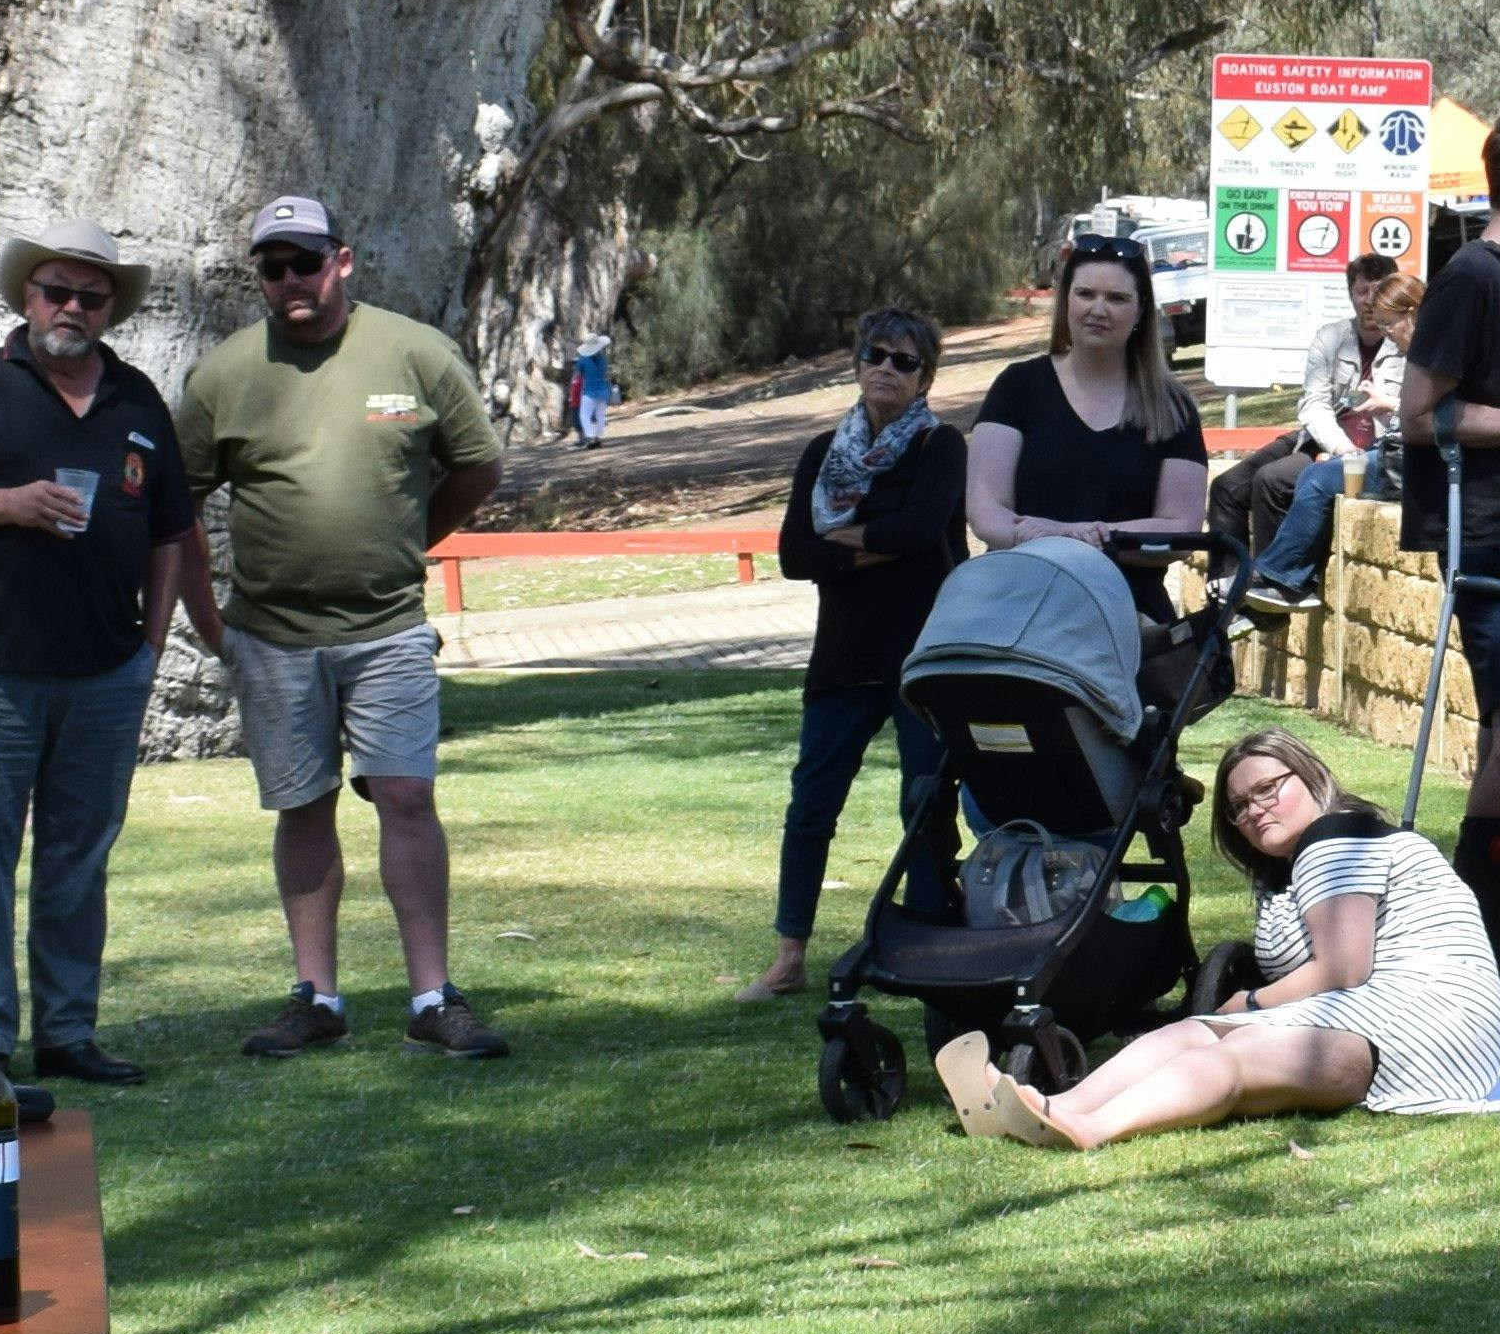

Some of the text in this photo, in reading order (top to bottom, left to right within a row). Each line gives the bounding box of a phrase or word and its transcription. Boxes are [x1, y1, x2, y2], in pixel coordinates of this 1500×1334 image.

[1221, 63, 1423, 81] BOATING SAFETY INFORMATION
[1255, 81, 1388, 97] EUSTON BOAT RAMP
[1226, 189, 1268, 200] GO EASY
[1233, 202, 1248, 210] THE
[1250, 203, 1275, 211] DRINK
[1295, 200, 1344, 212] YOU TOW
